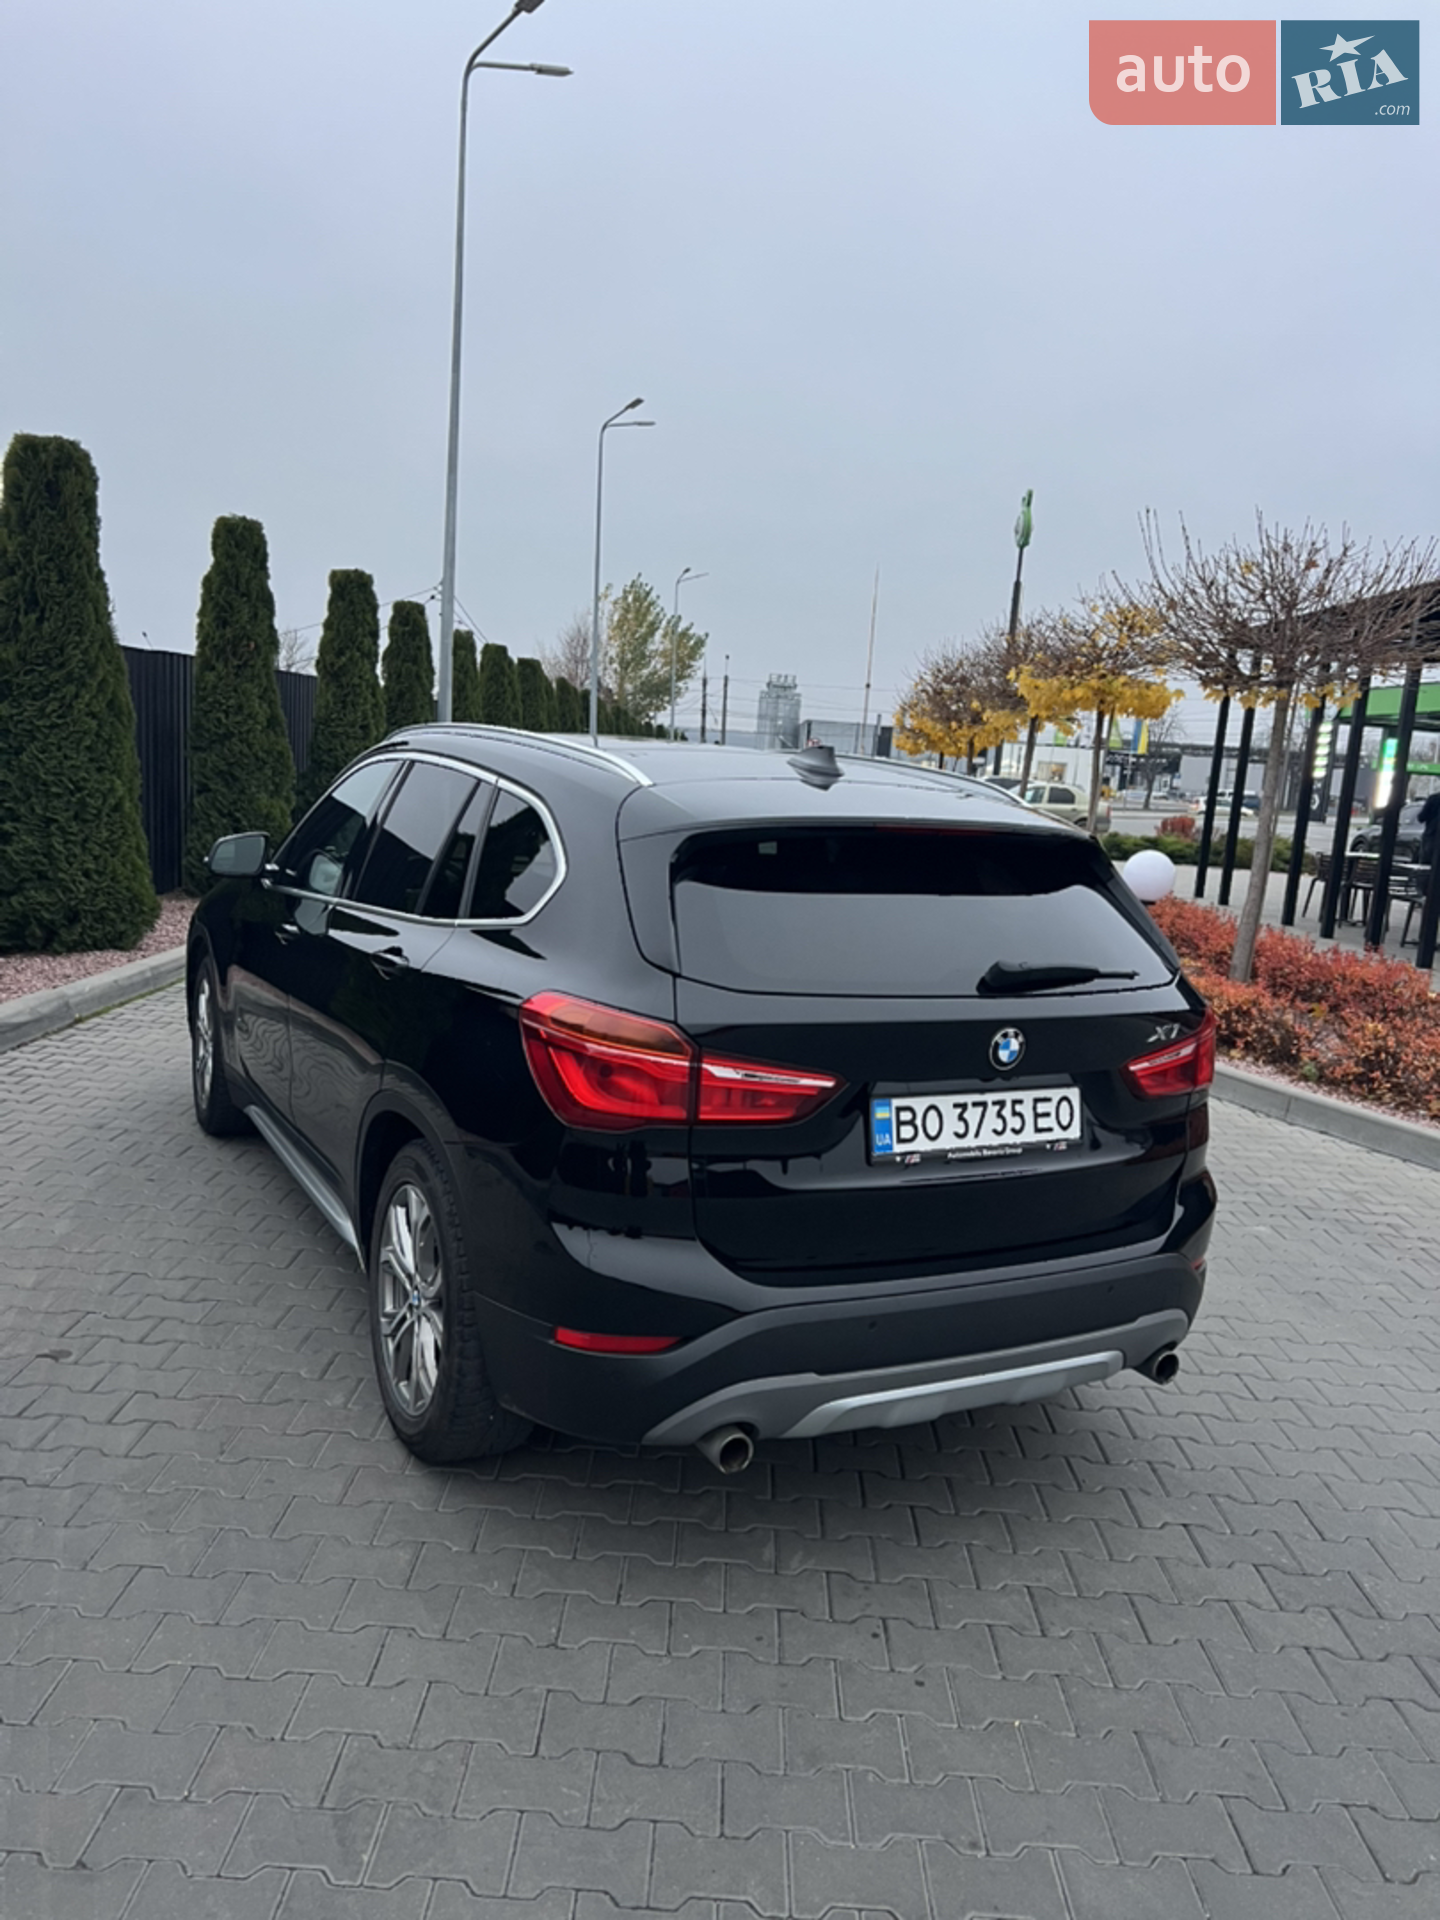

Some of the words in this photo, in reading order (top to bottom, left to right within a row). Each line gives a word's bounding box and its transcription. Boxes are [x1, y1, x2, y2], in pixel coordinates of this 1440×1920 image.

[1147, 1023, 1181, 1043] X1
[895, 1104, 943, 1144] BO
[952, 1099, 1026, 1139] 3735
[1033, 1095, 1074, 1134] EO
[875, 1133, 892, 1146] UA
